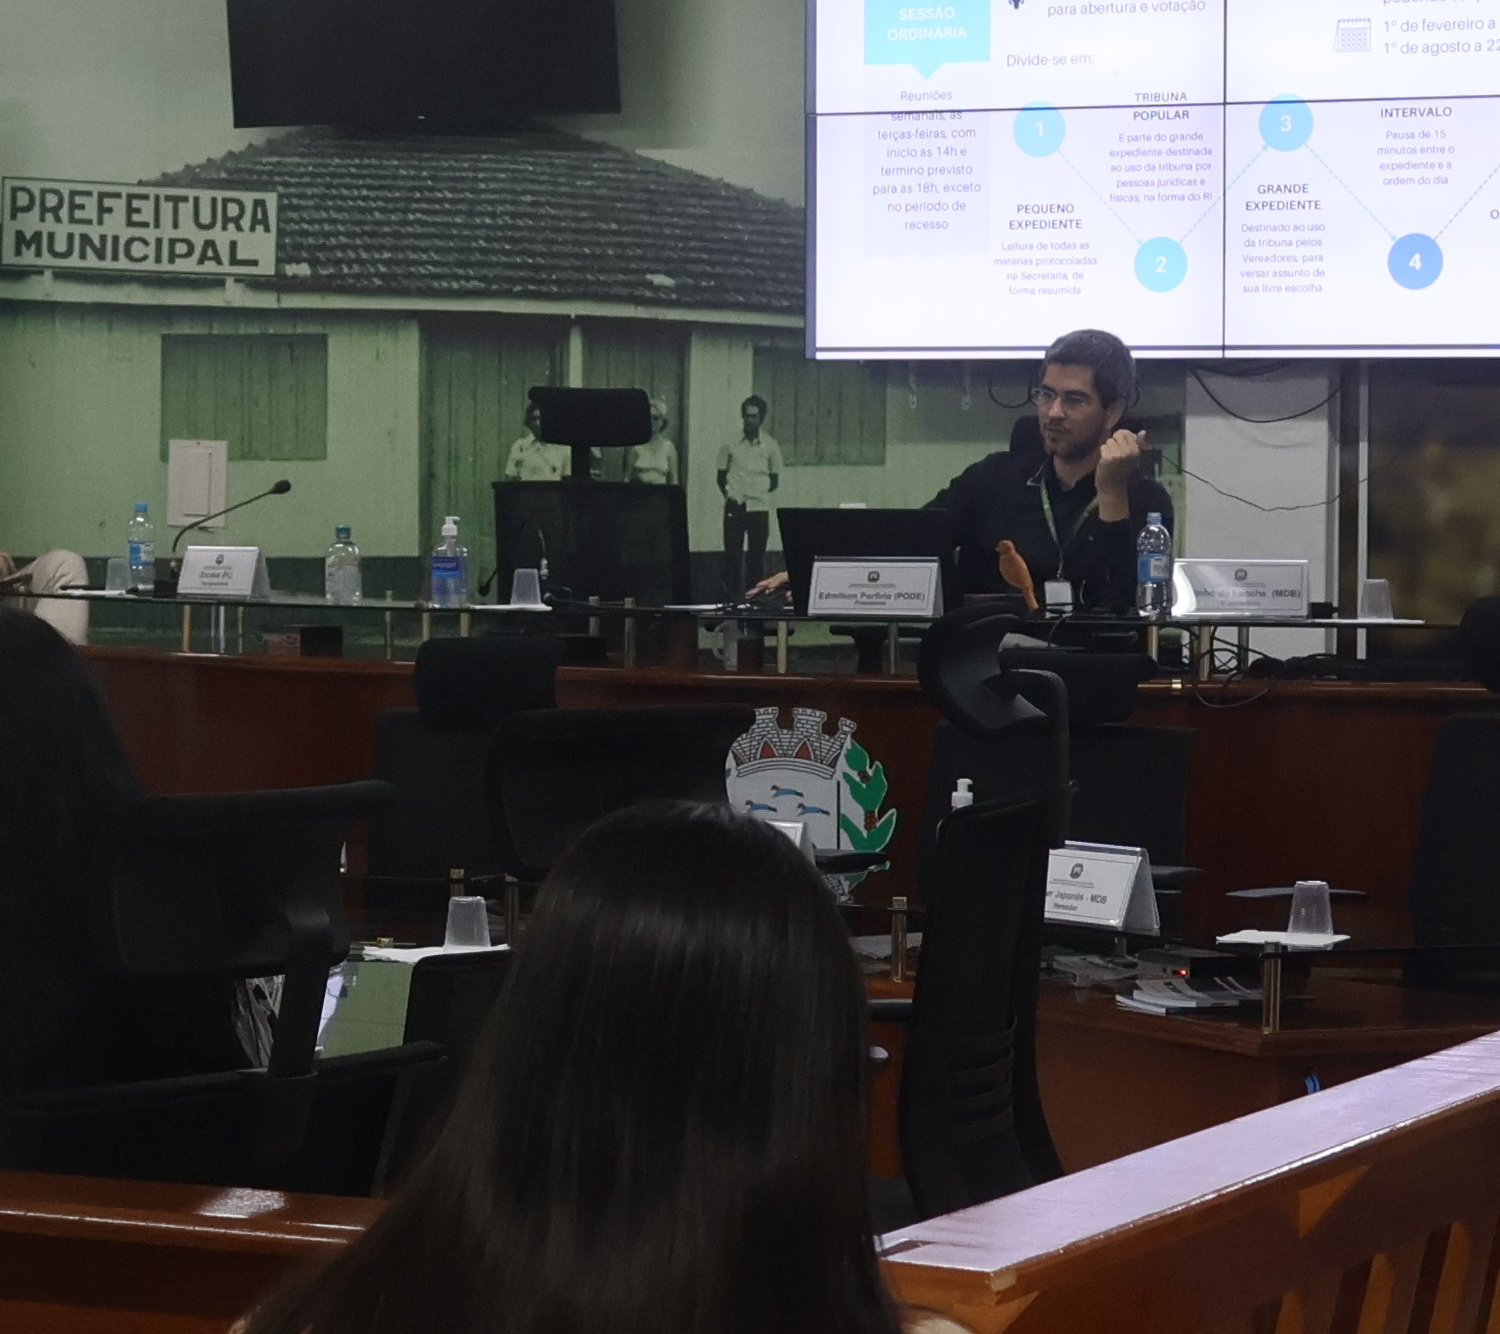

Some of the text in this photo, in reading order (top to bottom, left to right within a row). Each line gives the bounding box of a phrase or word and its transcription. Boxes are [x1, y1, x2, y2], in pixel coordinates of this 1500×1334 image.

[899, 6, 955, 20] SESSÃO
[1048, 0, 1206, 18] para abertura votação
[1400, 19, 1418, 32] de
[1422, 18, 1484, 31] fevereiro
[888, 27, 967, 41] ORDINÁRIA
[1400, 42, 1418, 54] de
[1422, 41, 1470, 56] agosto
[1007, 54, 1093, 67] Divide-se em:
[901, 91, 952, 101] Reuniões
[1136, 93, 1186, 101] TRIBUNA
[1133, 110, 1189, 121] POPULAR
[1381, 107, 1452, 118] INTERVALO
[1035, 121, 1043, 137] 1
[1280, 115, 1292, 132] 3
[951, 129, 976, 138] com
[1127, 131, 1203, 143] parte do grande
[1386, 129, 1446, 139] Pausa de 15
[937, 146, 957, 156] 14h
[1377, 146, 1444, 155] minutos entre
[927, 165, 973, 177] previsto
[1383, 176, 1448, 185] ordem do dia
[873, 185, 897, 196] para
[943, 183, 981, 193] exceto
[1258, 184, 1308, 194] GRANDE
[10, 187, 271, 233] PREFEITURA
[888, 200, 966, 212] no de
[1017, 204, 1074, 214] PEQUENO
[1246, 200, 1320, 211] EXPEDIENTE
[905, 221, 948, 230] recesso
[1009, 219, 1082, 230] EXPEDIENTE
[1241, 224, 1290, 232] Destinado
[14, 229, 260, 267] MUNICIPAL
[1155, 255, 1166, 273] 2
[1408, 253, 1422, 271] 4
[894, 592, 924, 602] (PODE)
[1090, 894, 1108, 905] MDB
